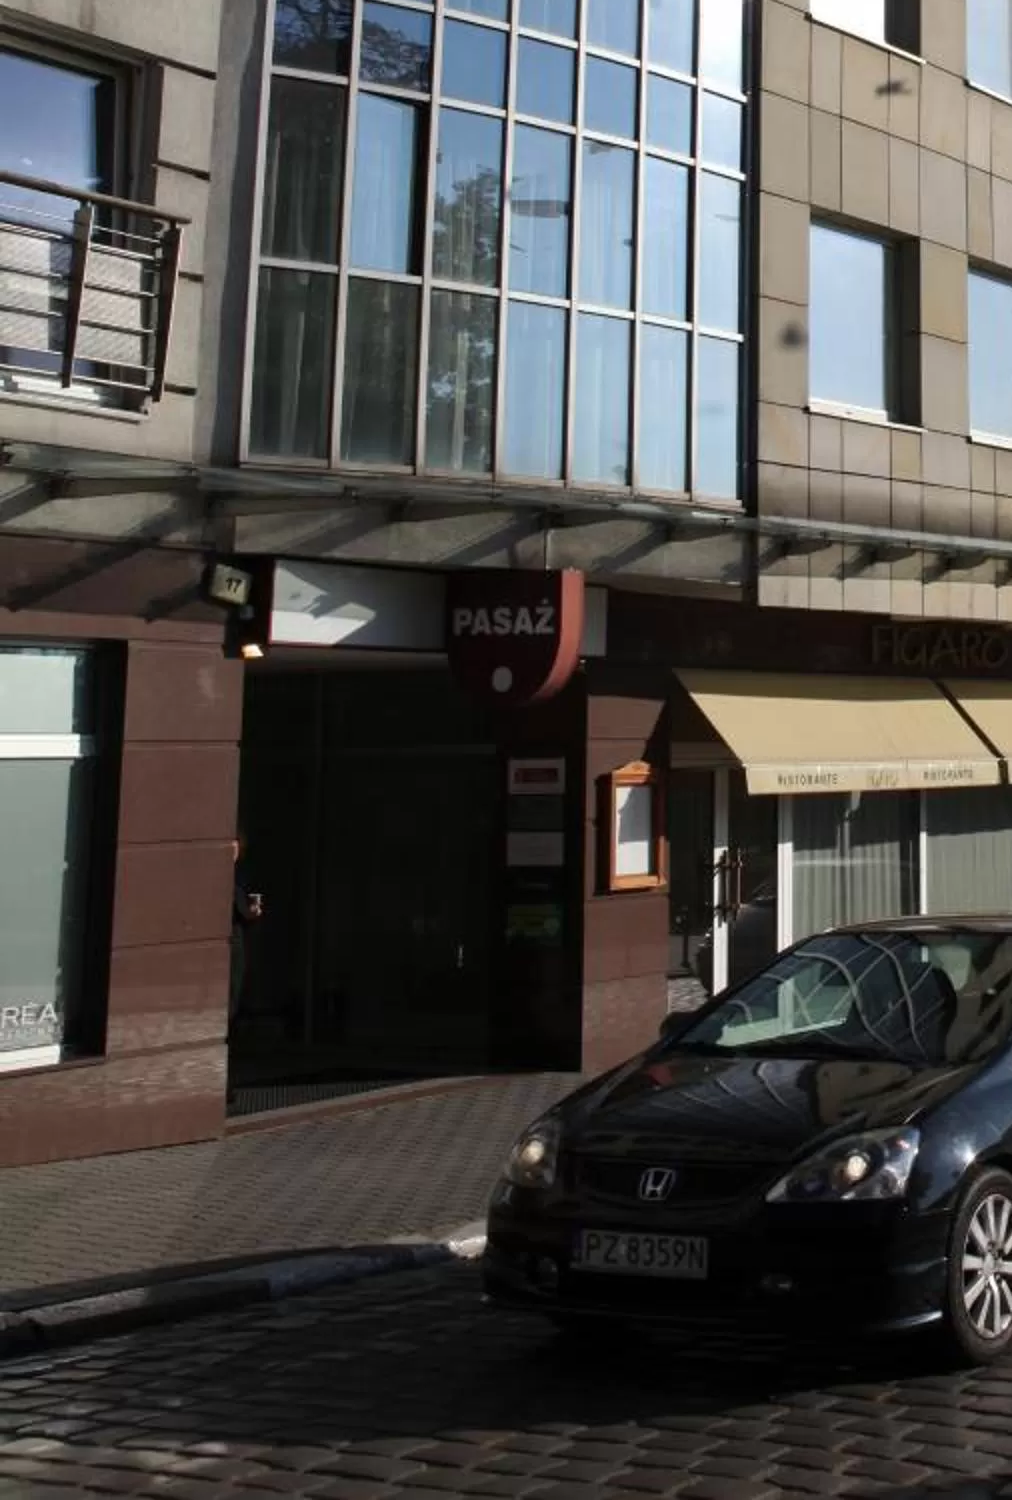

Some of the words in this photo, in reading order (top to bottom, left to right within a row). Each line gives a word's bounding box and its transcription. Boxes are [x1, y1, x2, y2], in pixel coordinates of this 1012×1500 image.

[225, 577, 242, 594] 17
[452, 598, 557, 637] PASAŻ
[871, 624, 1010, 670] FIGARO
[586, 1233, 618, 1265] PZ
[626, 1236, 704, 1269] 8359N
